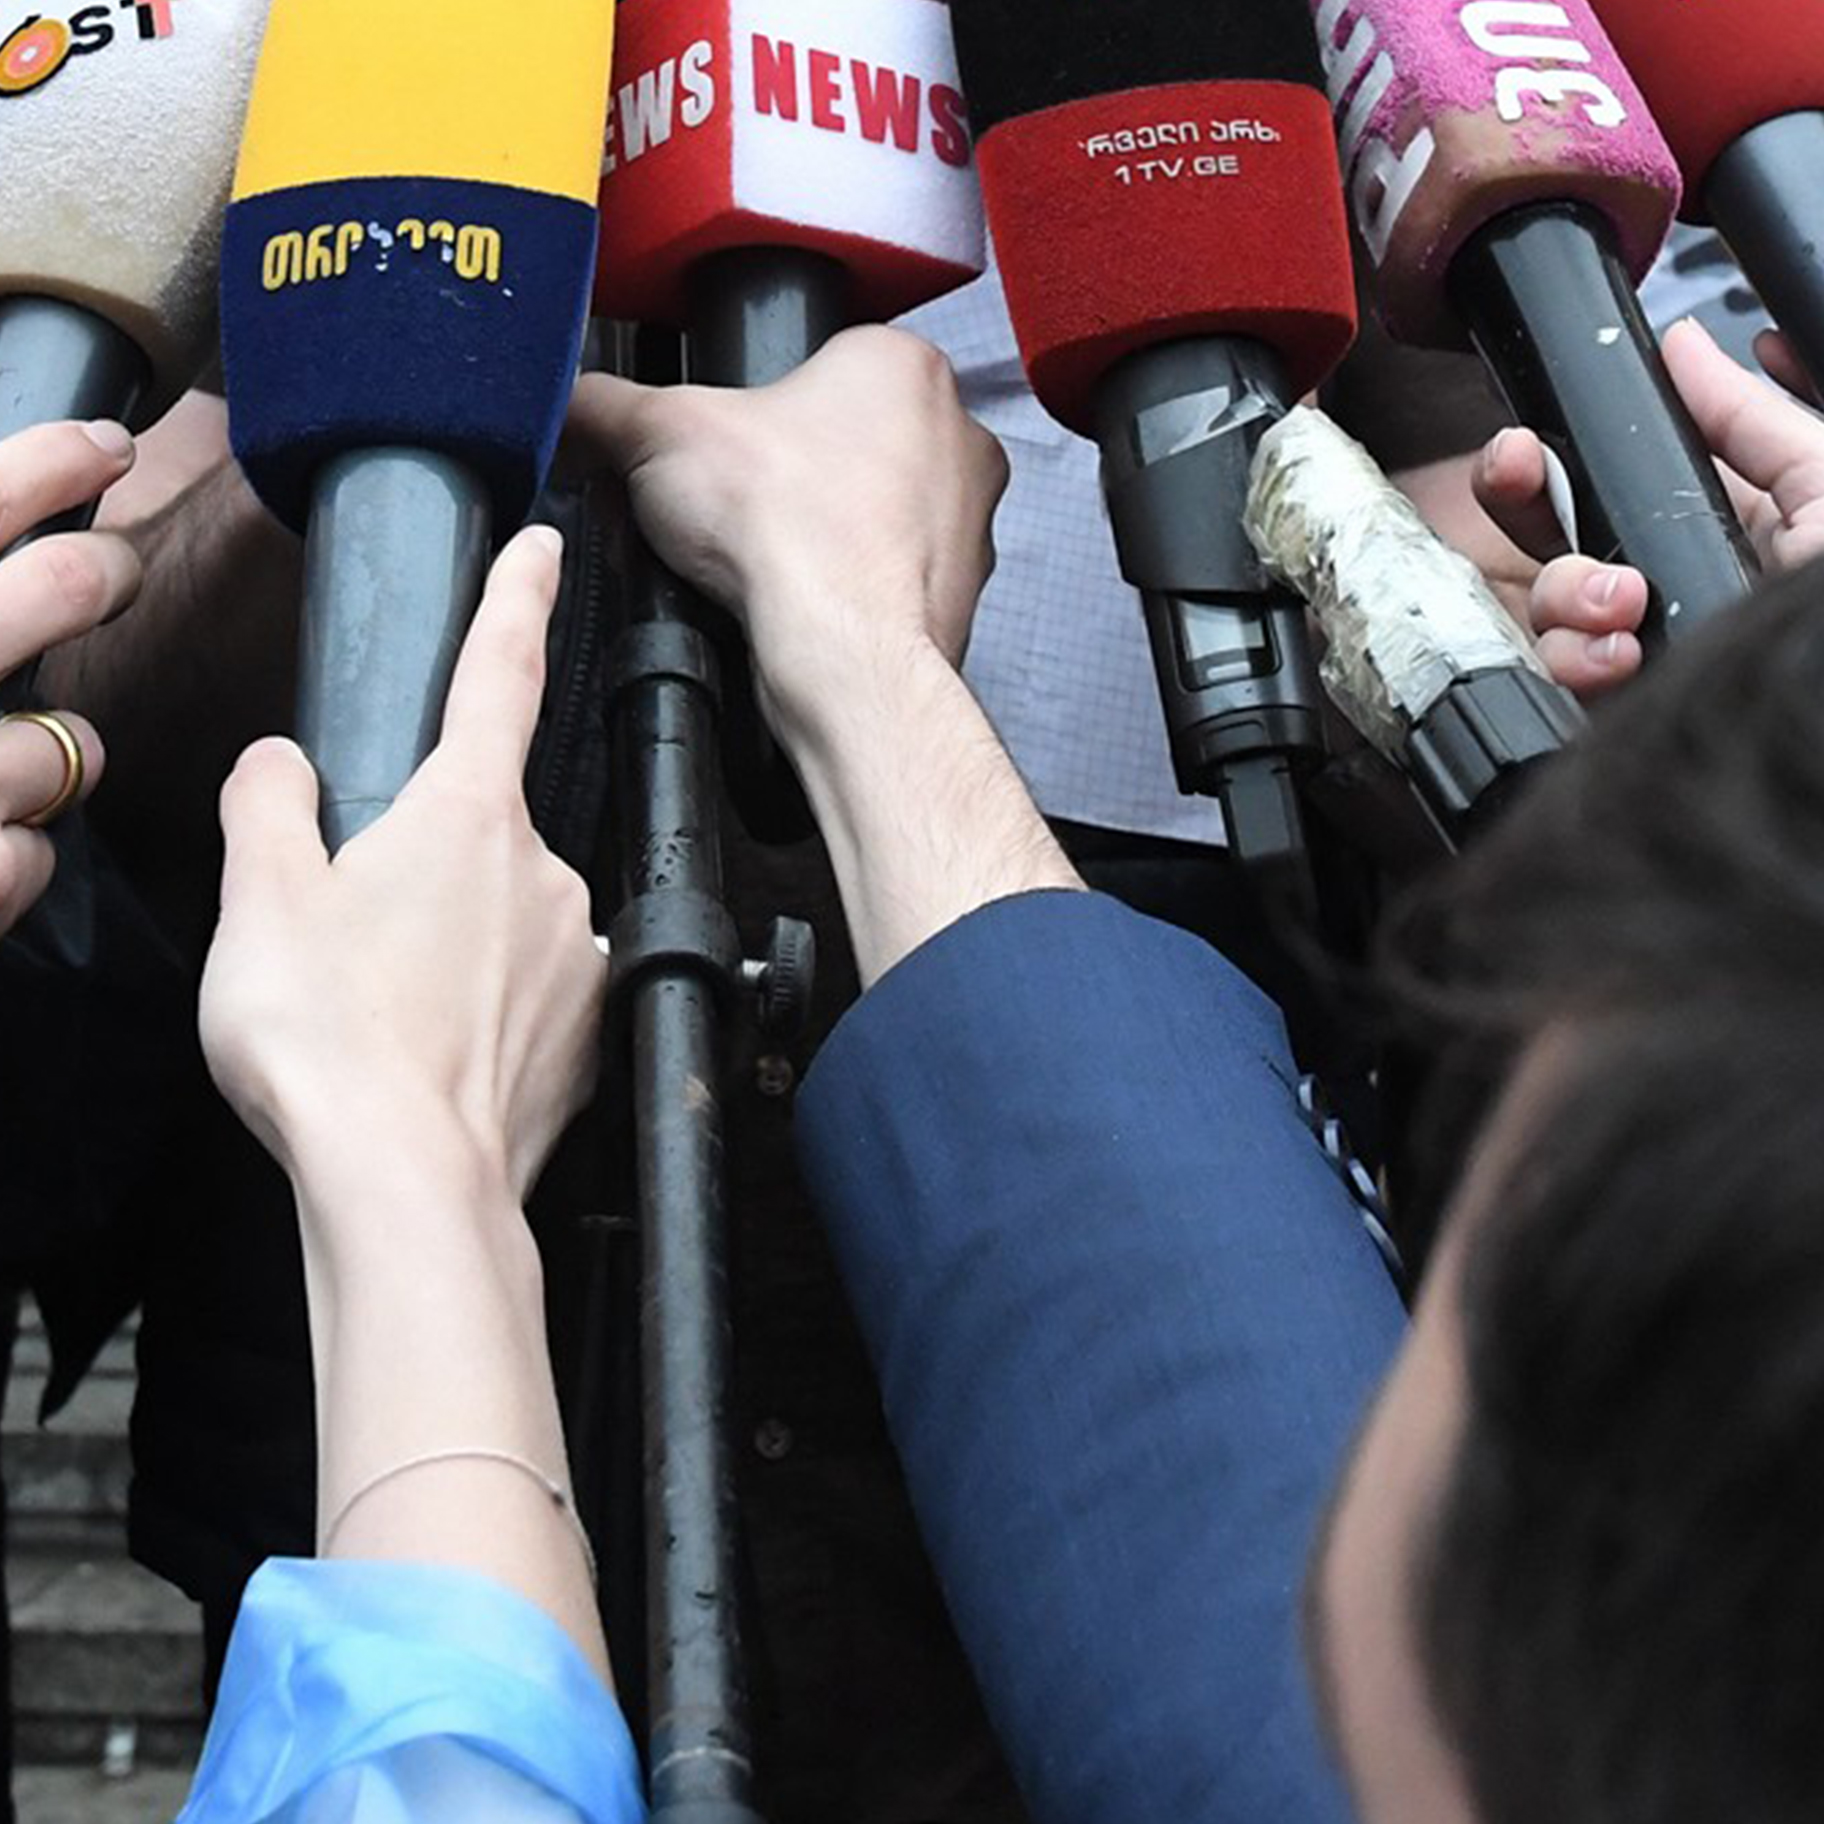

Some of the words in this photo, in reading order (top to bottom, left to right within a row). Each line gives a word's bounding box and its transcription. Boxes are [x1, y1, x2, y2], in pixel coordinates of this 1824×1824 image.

[751, 33, 974, 169] NEWS
[1077, 120, 1200, 158] რველი
[1209, 120, 1281, 142] არხ
